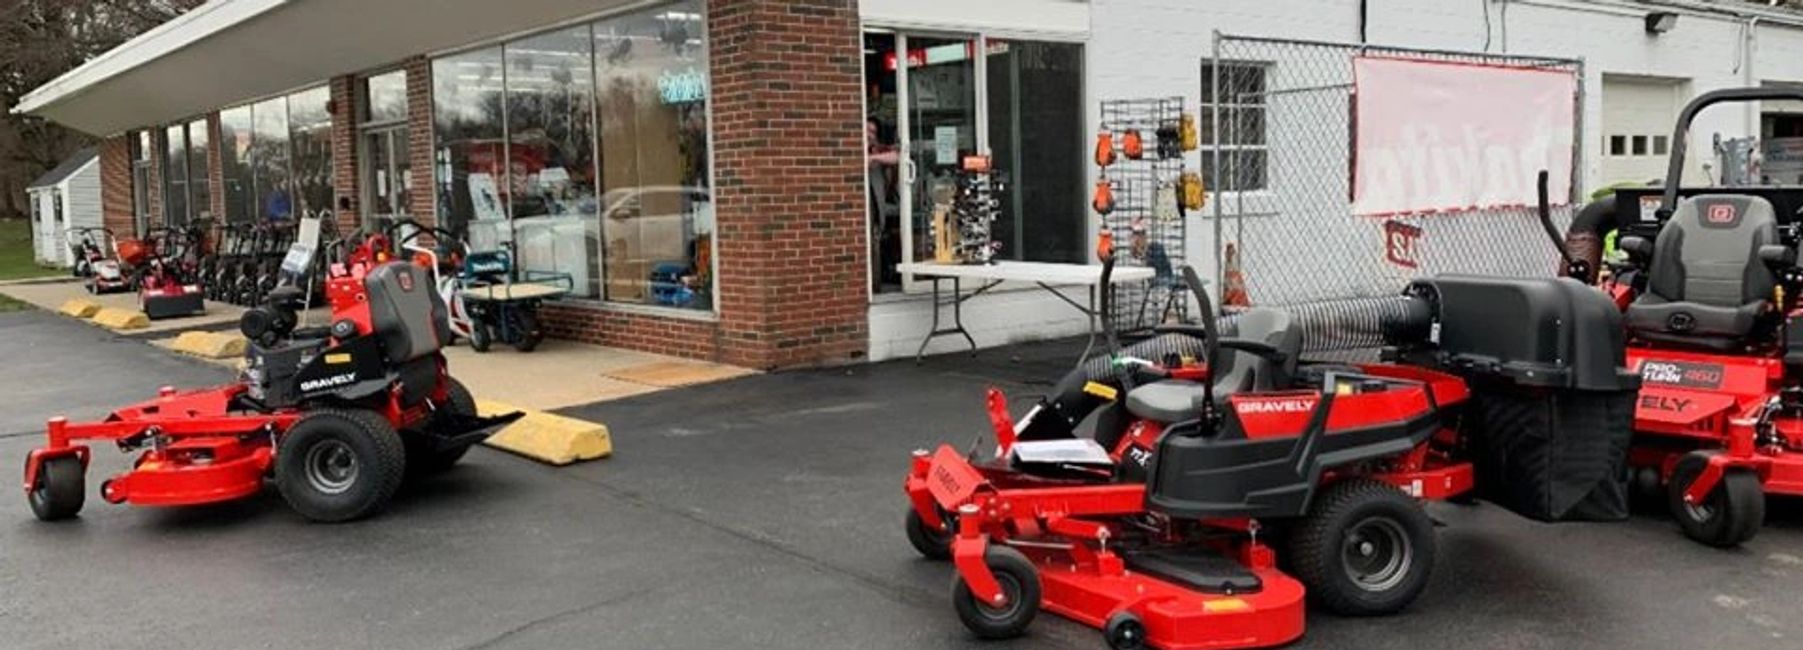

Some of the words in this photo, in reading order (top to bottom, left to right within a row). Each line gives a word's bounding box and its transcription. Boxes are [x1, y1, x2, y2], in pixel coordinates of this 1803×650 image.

[300, 372, 356, 391] GRAVELY
[1238, 399, 1315, 414] GRAVELY
[1640, 394, 1692, 413] ELY
